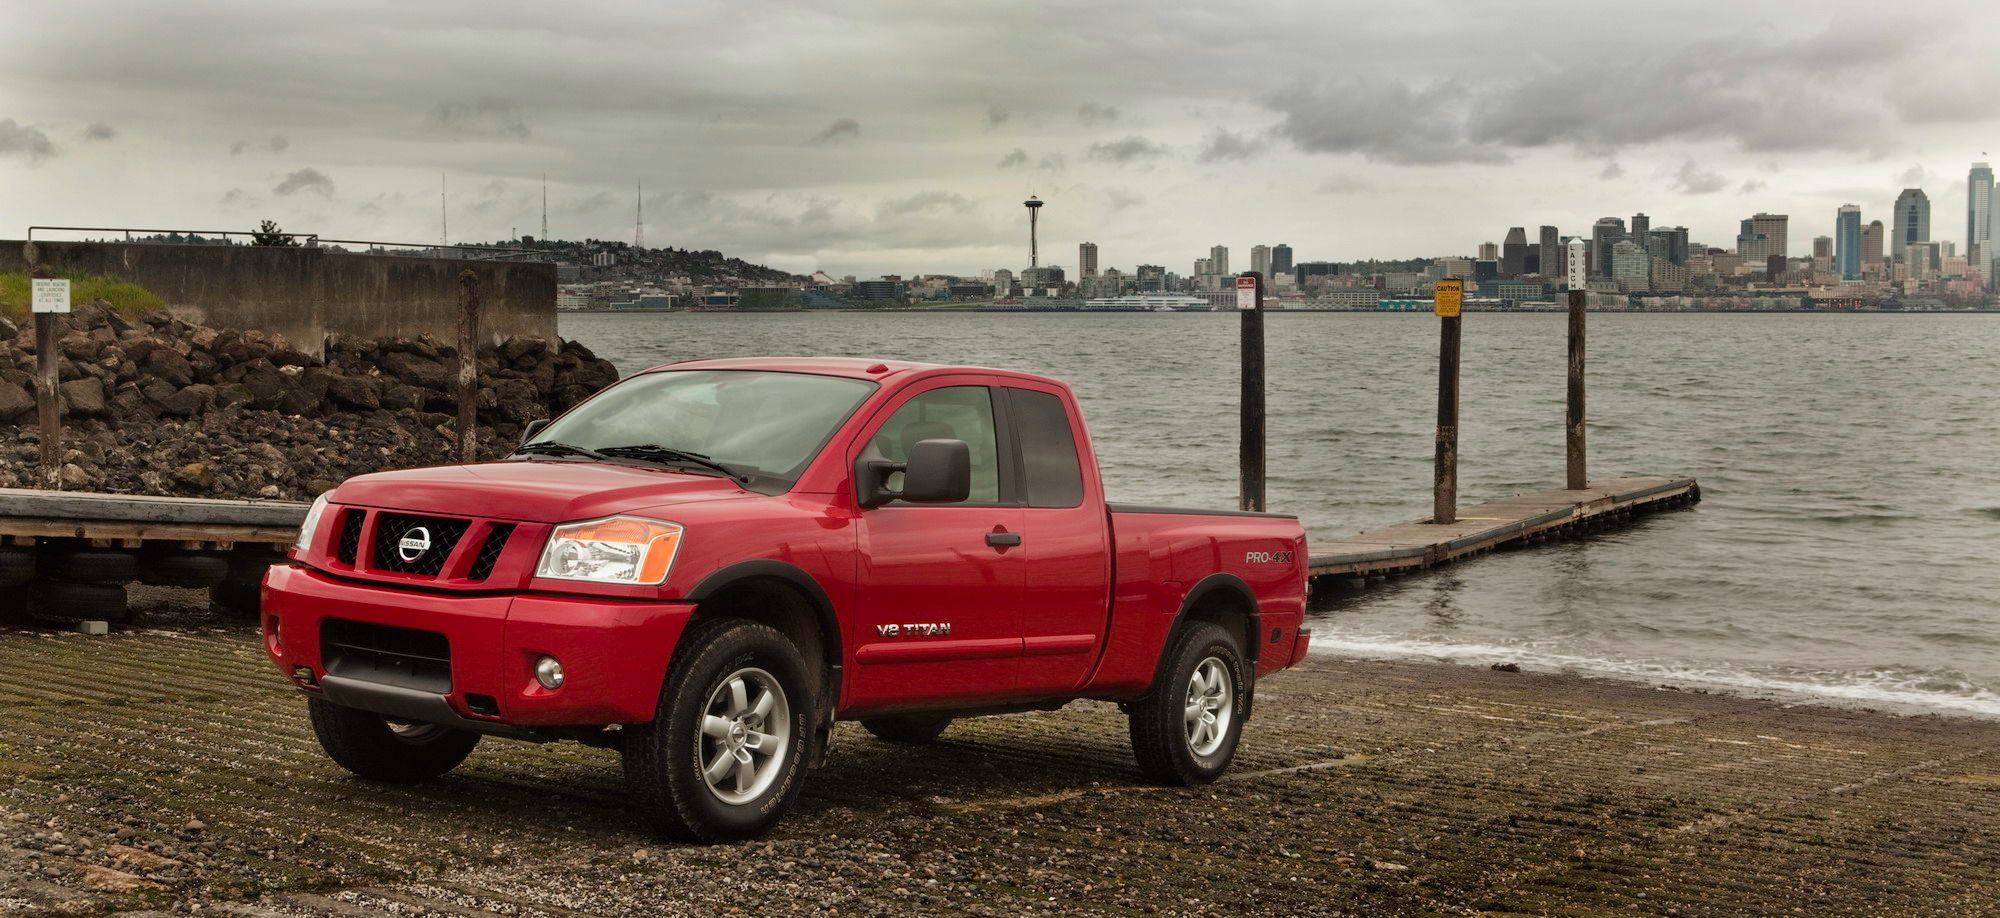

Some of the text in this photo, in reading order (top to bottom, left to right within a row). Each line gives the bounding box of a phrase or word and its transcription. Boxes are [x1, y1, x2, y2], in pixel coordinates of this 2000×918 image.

[401, 540, 425, 549] NISSAN
[1245, 550, 1293, 564] PRO-4X
[876, 622, 951, 637] V8 TITAN
